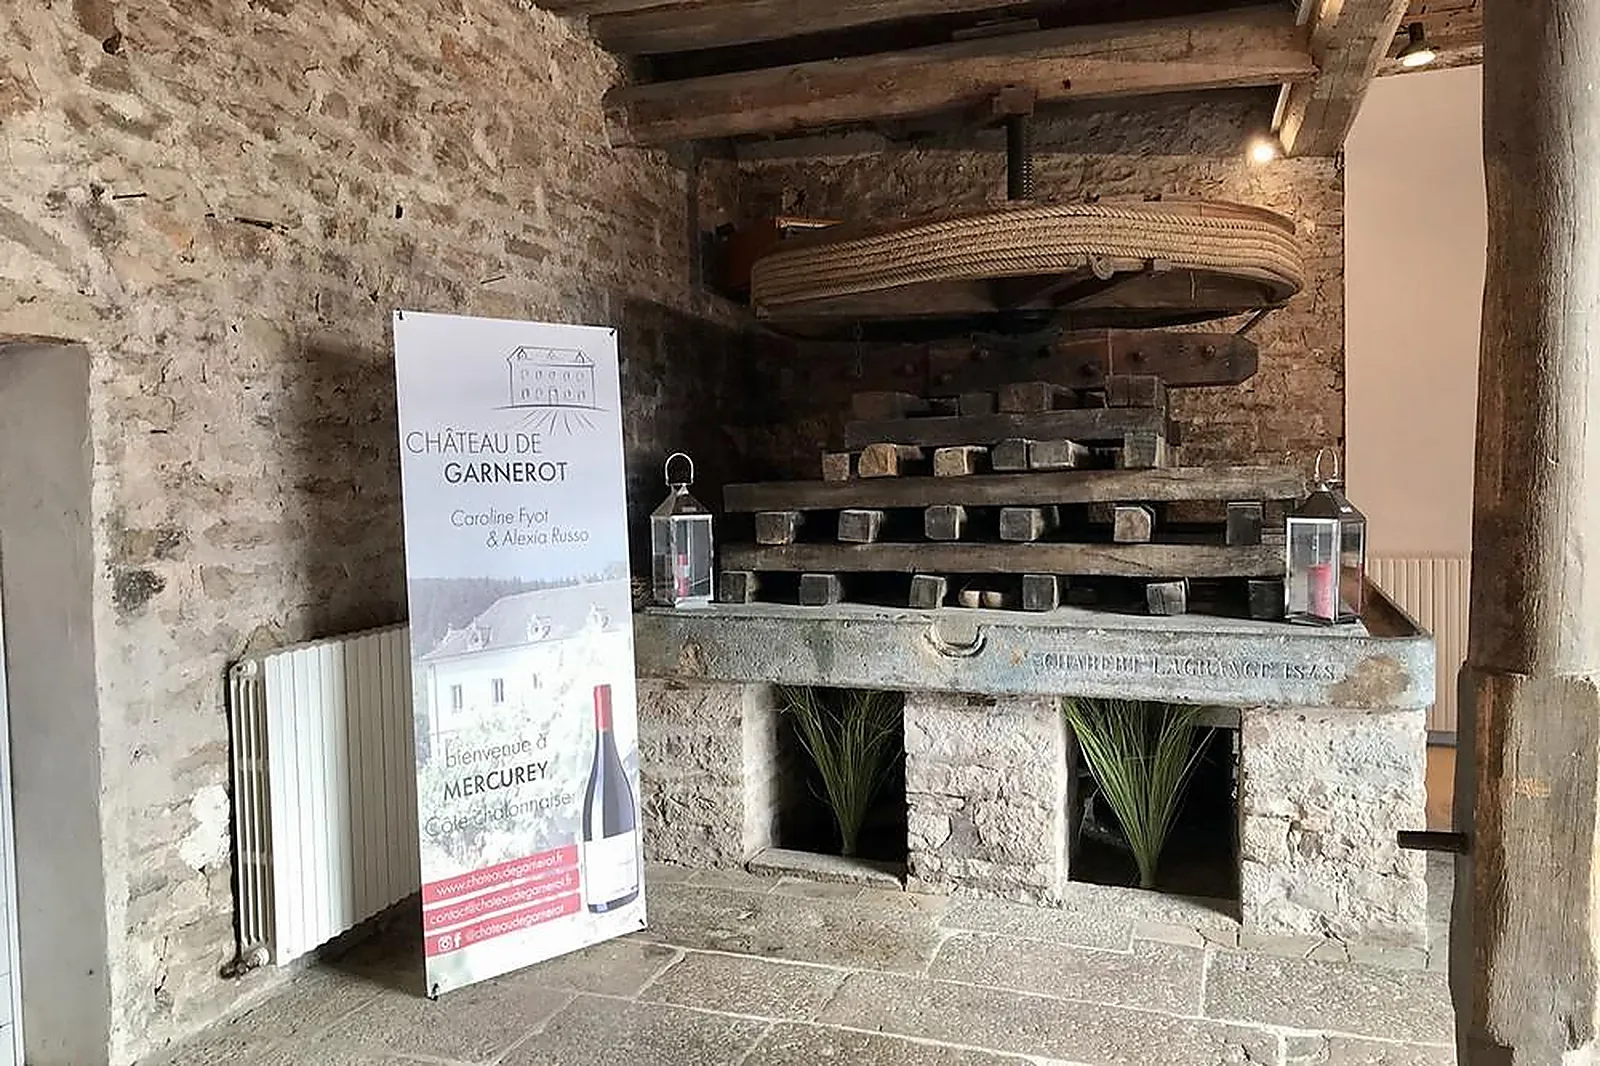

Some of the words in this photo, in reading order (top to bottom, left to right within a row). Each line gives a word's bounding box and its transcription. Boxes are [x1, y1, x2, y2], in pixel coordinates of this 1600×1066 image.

[406, 427, 509, 454] CHÂTEAU
[516, 433, 542, 454] DE
[444, 461, 568, 483] GARNEROT
[451, 507, 514, 527] Caroline
[519, 506, 549, 528] Fyot
[485, 531, 499, 548] &
[502, 529, 548, 546] Alexia
[552, 527, 590, 545] Russo
[445, 738, 532, 768] bienvenue
[444, 760, 549, 801] MERCUREY
